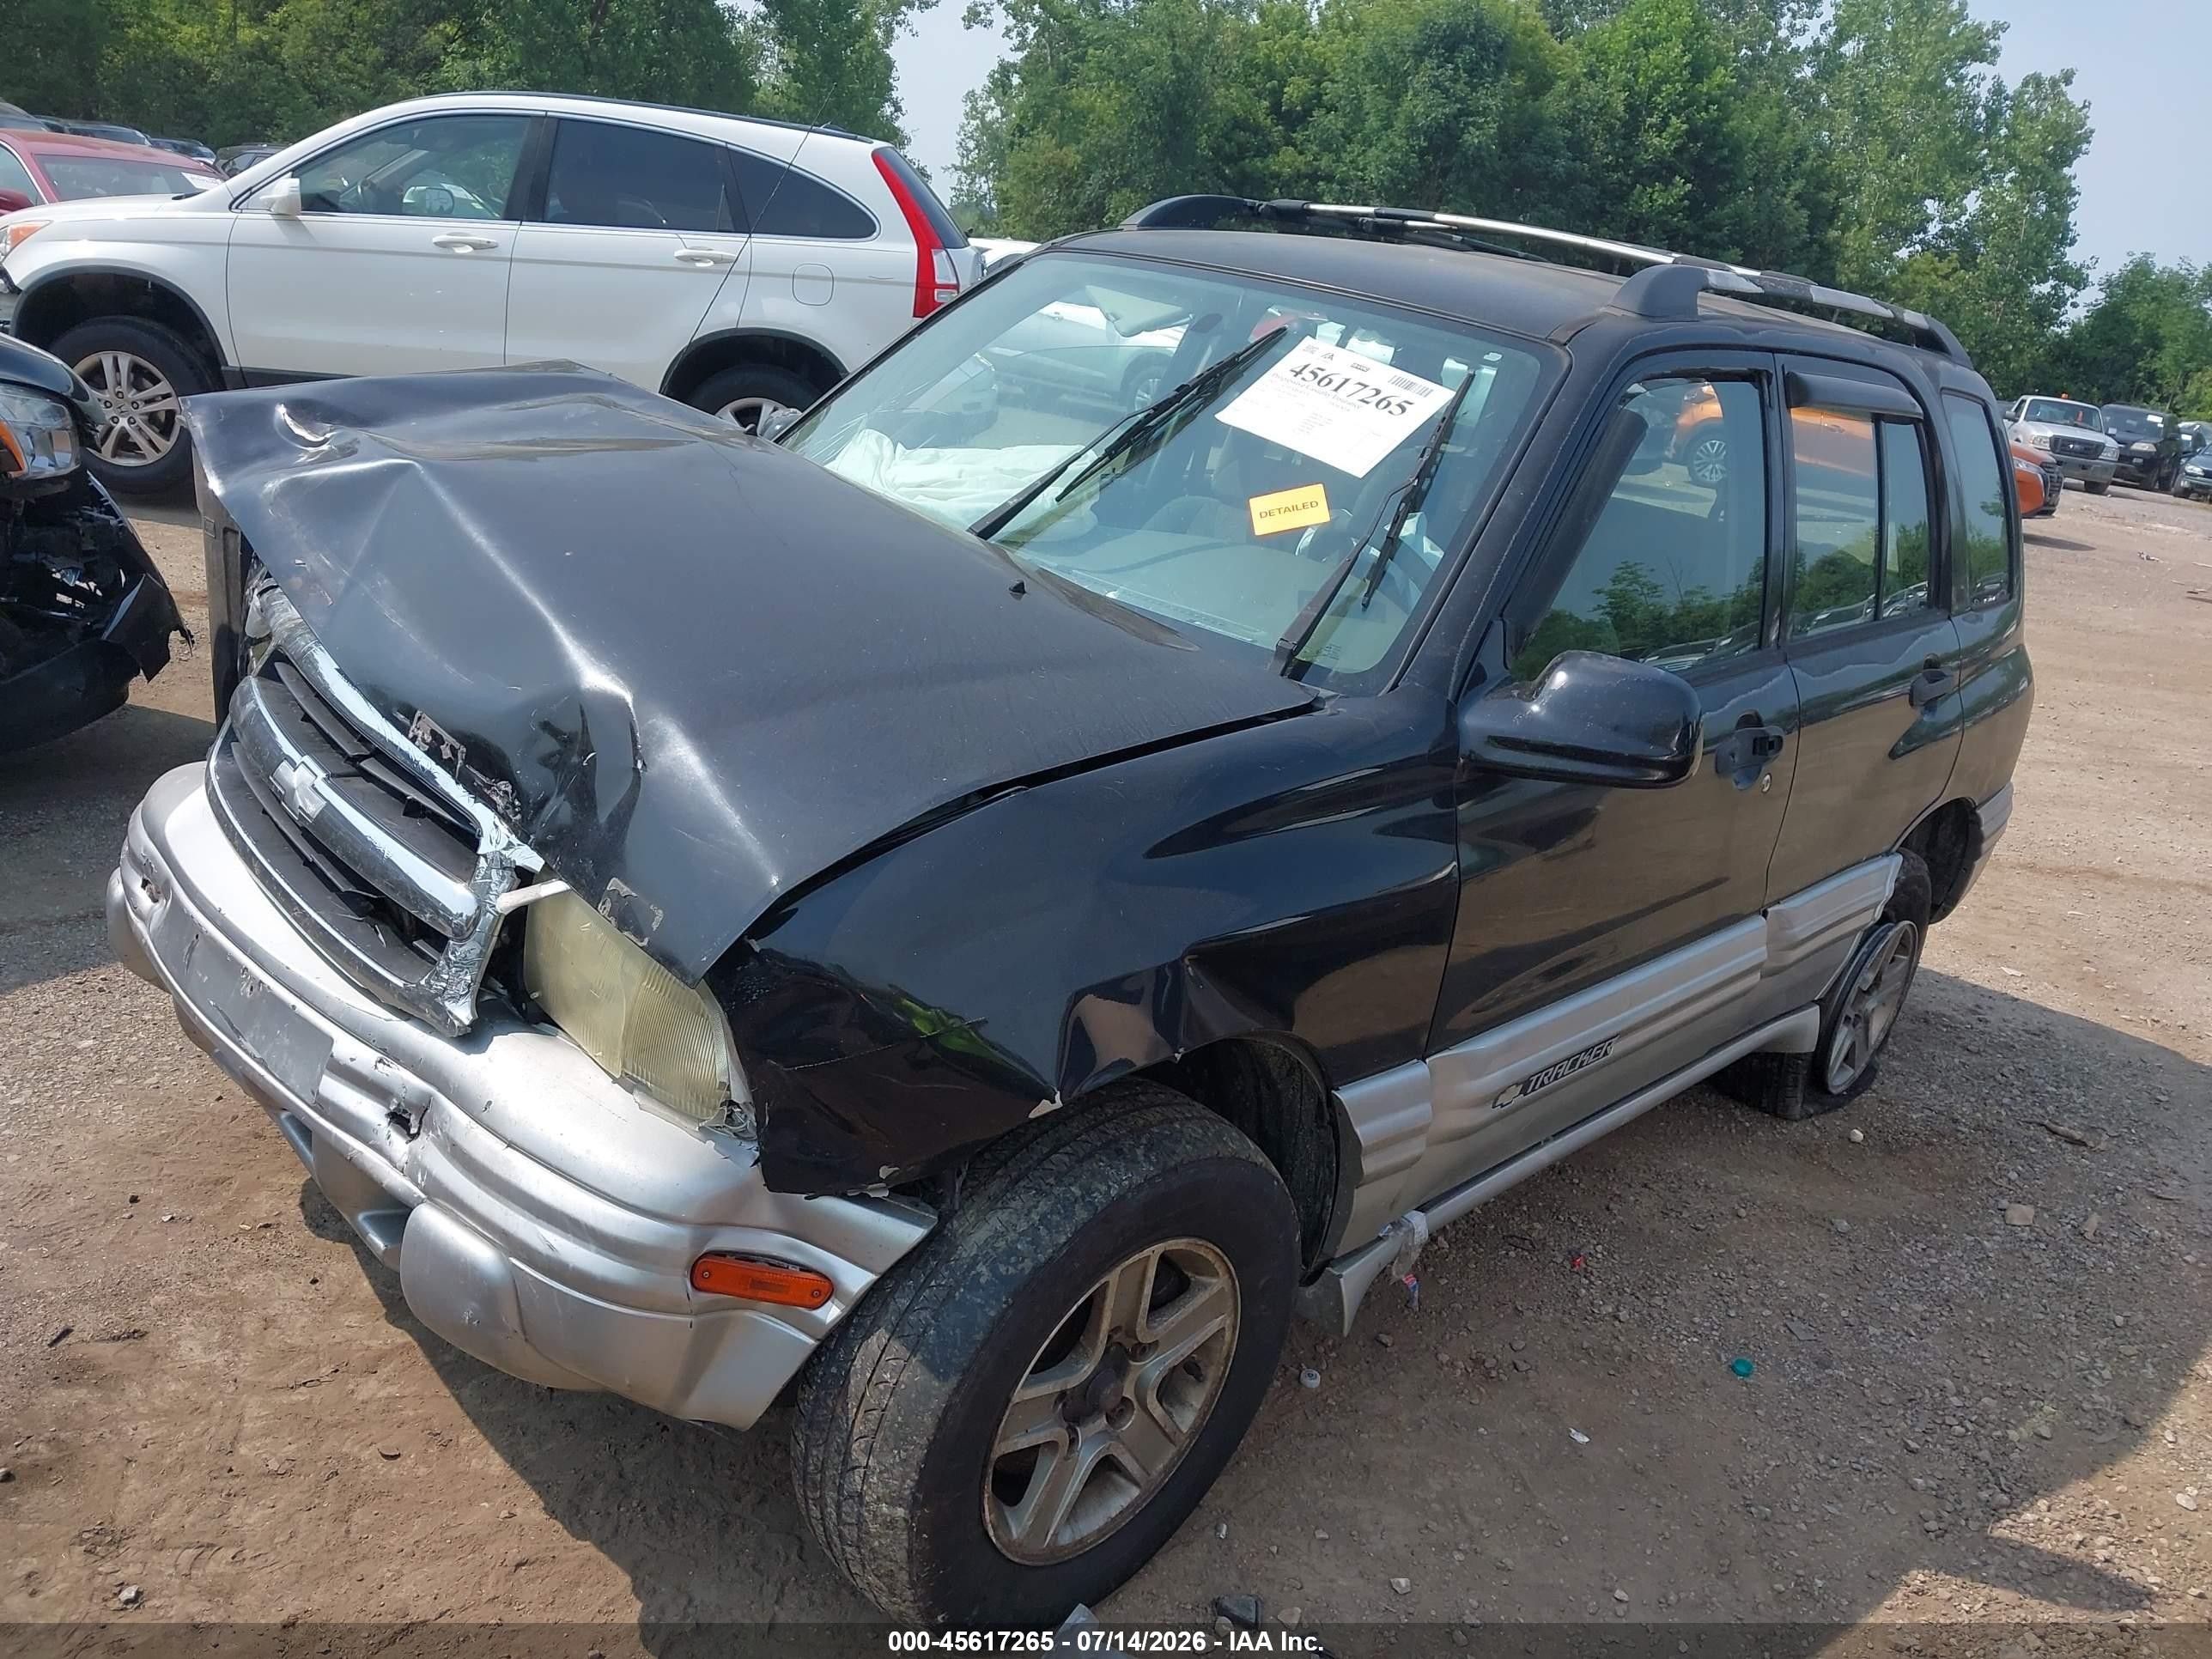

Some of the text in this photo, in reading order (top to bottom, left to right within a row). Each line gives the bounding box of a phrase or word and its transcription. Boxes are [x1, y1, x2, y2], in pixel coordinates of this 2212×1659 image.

[1290, 363, 1415, 416] 45617265
[1259, 501, 1319, 520] DETAILED
[1527, 1036, 1616, 1093] TRACKER
